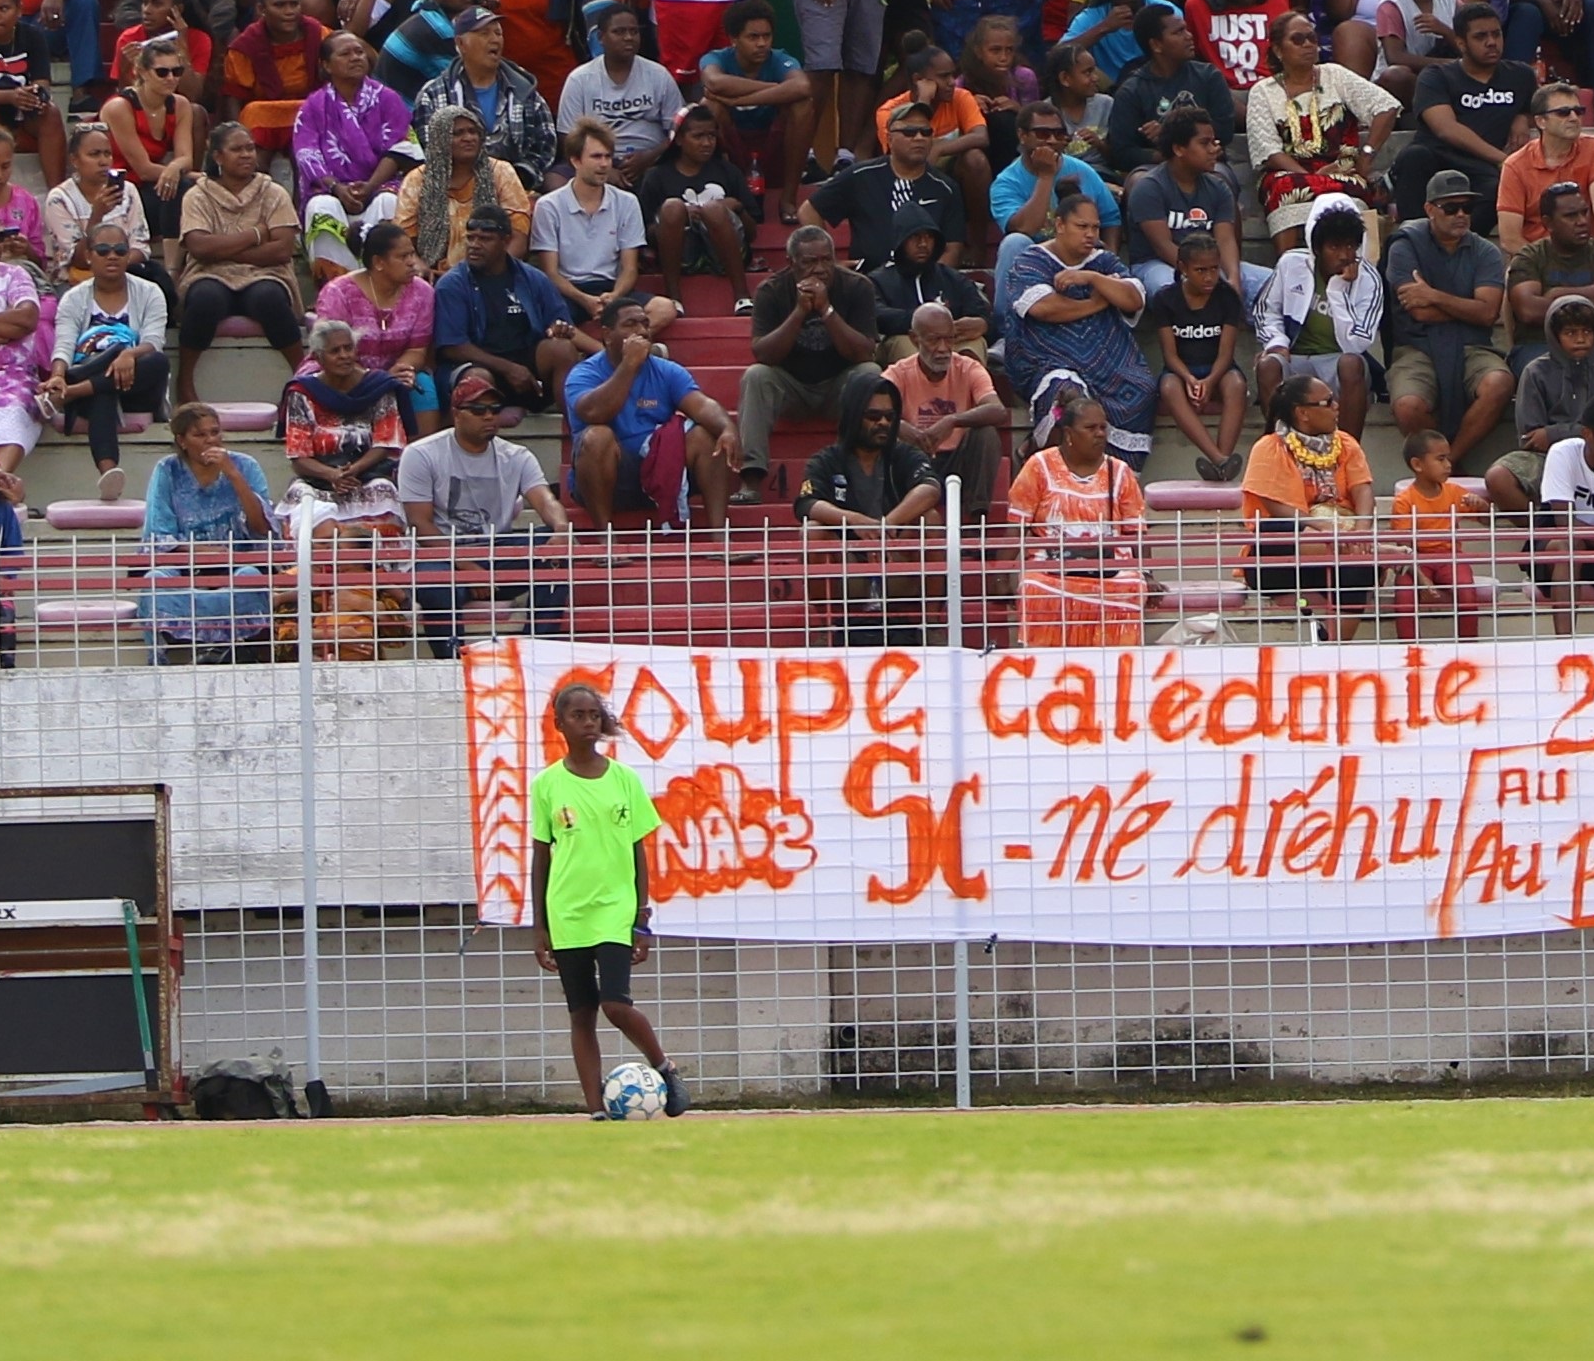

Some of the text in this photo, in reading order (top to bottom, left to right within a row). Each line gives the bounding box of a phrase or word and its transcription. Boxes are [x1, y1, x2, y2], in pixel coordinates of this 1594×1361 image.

[1209, 13, 1268, 41] JUST
[1218, 41, 1259, 70] DO
[591, 94, 654, 113] Reebok
[1461, 86, 1515, 110] adidas
[1172, 324, 1222, 339] adidas
